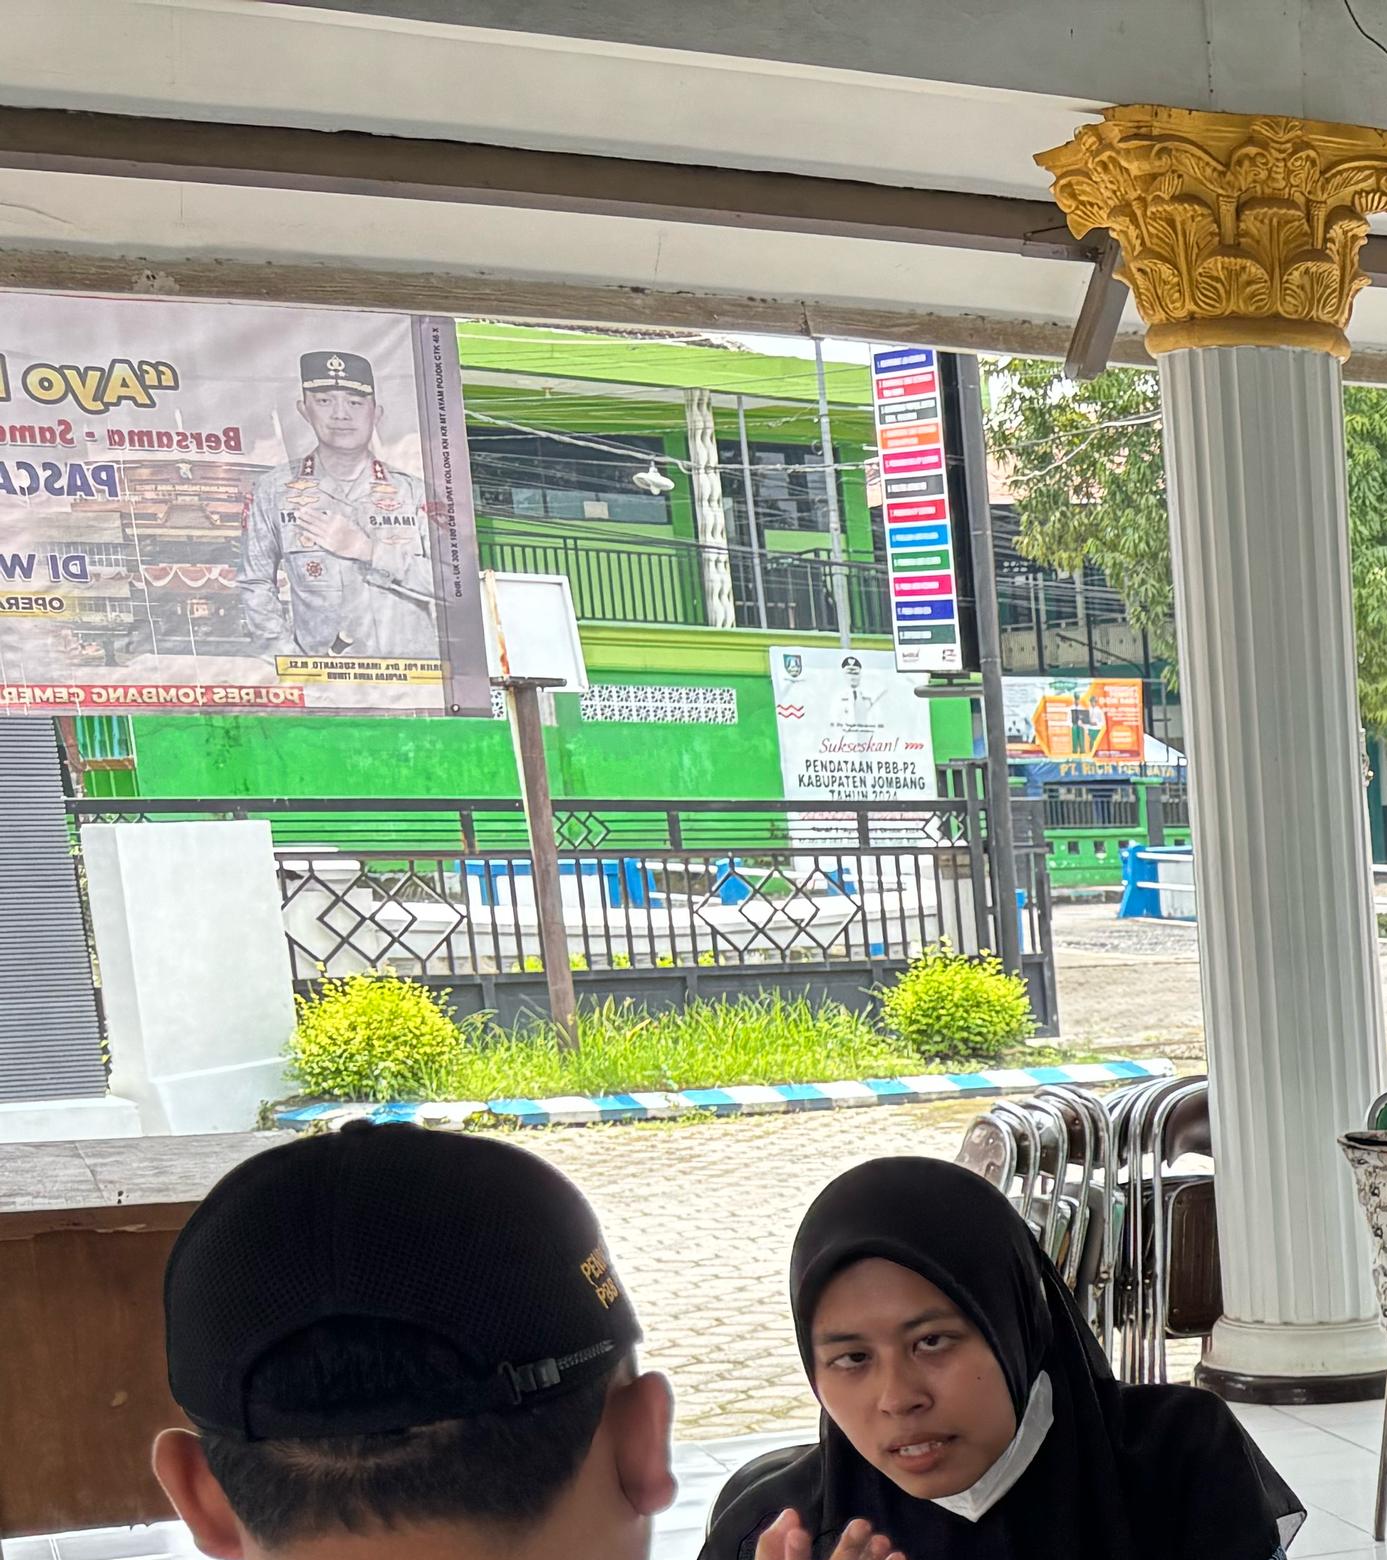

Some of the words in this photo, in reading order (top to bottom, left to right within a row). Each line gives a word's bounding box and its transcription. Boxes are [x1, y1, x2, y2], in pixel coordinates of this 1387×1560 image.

[435, 363, 444, 389] POJOK
[437, 391, 446, 412] AYAM
[819, 735, 900, 753] Sukseskan!
[805, 759, 874, 774] PENDATAAN
[877, 761, 917, 775] PBB-P2
[798, 774, 867, 789] KABUPATEN
[871, 776, 926, 790] JOMBANG
